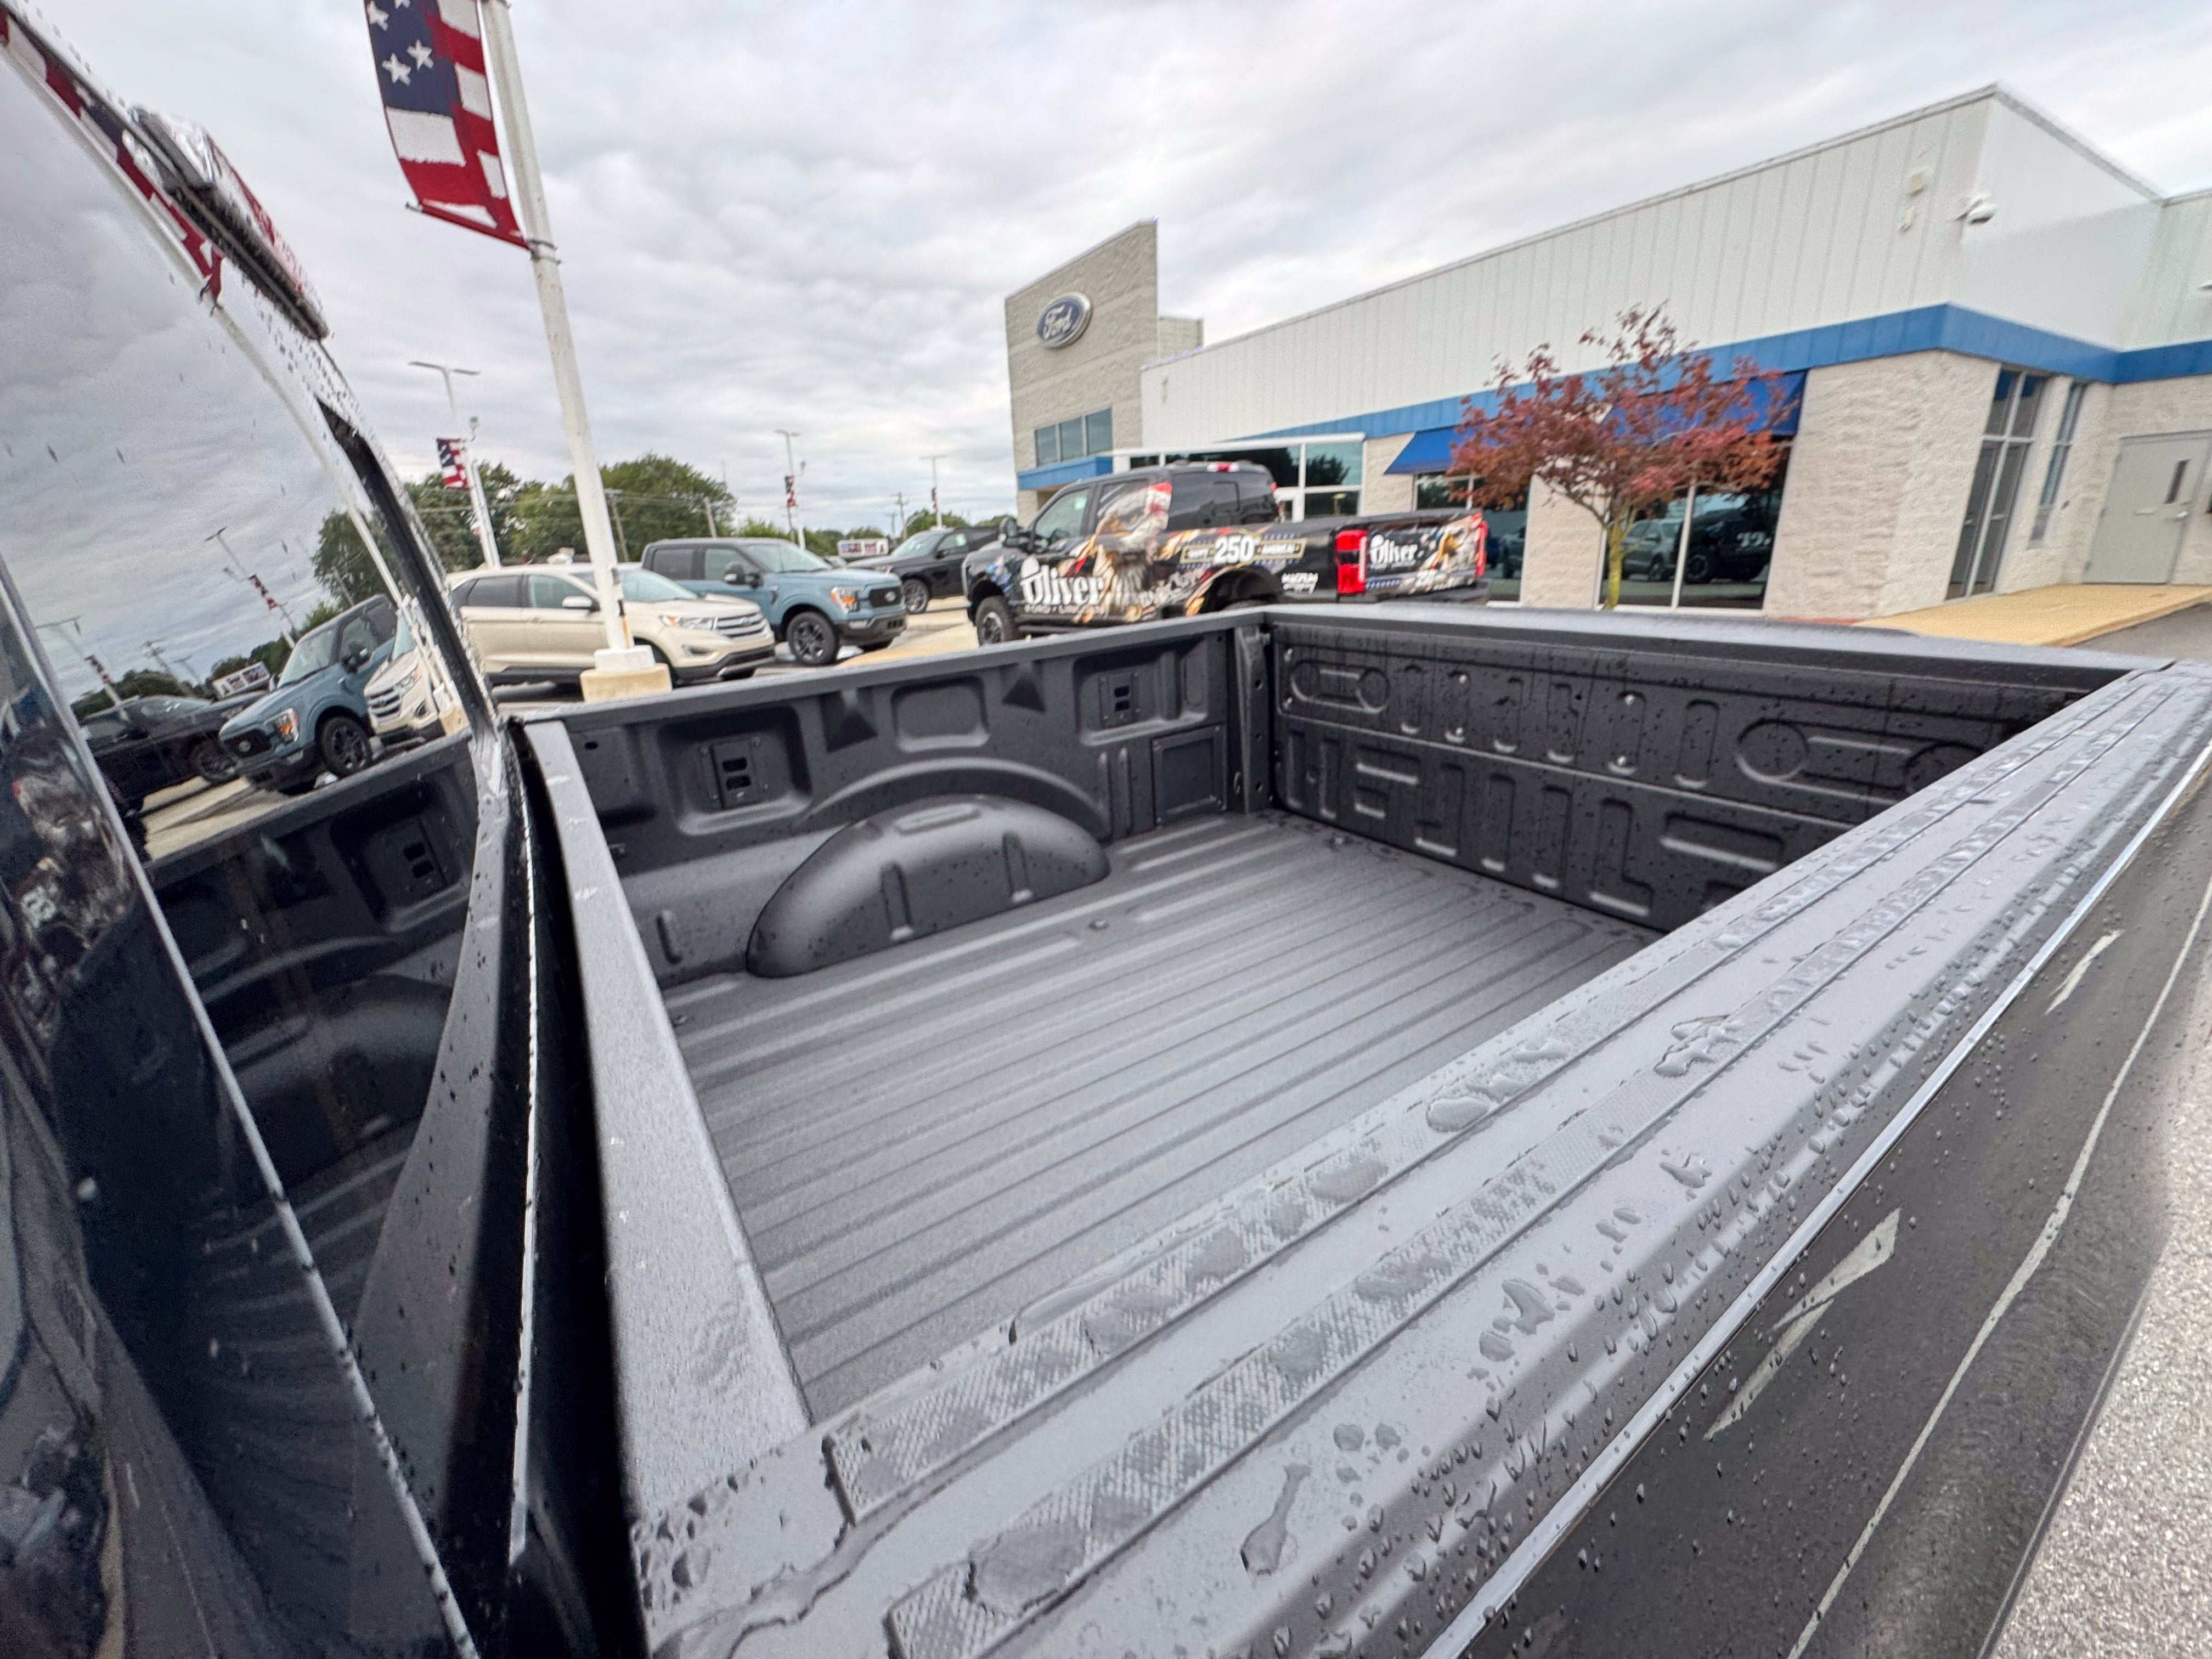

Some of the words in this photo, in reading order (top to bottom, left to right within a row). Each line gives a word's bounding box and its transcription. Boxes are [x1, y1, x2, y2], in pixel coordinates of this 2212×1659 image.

[1043, 304, 1073, 340] Ford
[1369, 534, 1418, 565] Oliver
[1020, 555, 1104, 605] Oliver
